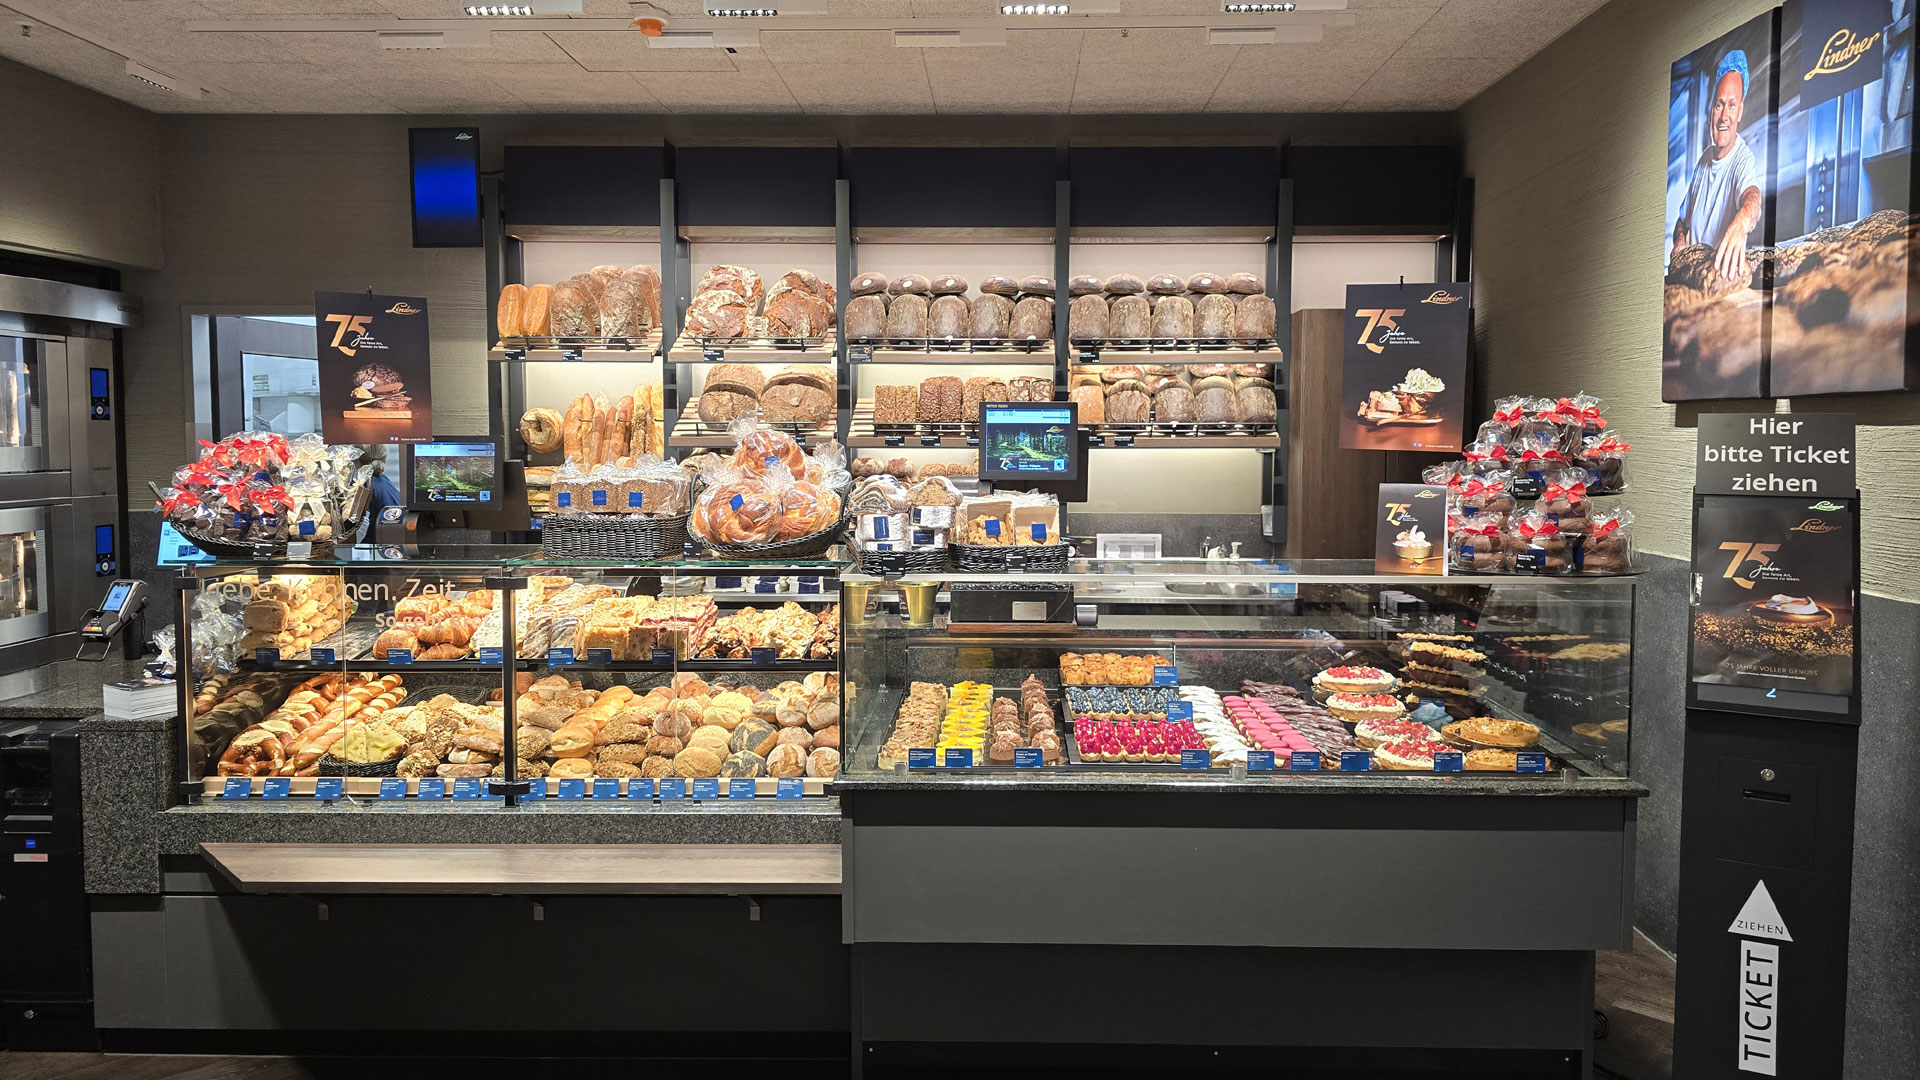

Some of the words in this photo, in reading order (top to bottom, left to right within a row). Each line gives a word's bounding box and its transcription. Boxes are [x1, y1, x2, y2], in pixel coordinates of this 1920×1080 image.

[1803, 28, 1880, 81] Lindner
[1420, 289, 1463, 305] Lindner
[385, 301, 422, 315] Lindner
[324, 313, 373, 357] 75
[1354, 308, 1407, 354] 75
[1750, 418, 1803, 435] Hier
[1704, 445, 1763, 463] bitte
[1770, 445, 1850, 464] Ticket
[1732, 473, 1817, 492] ziehen
[1385, 503, 1412, 526] 75
[1807, 500, 1845, 511] Lindner
[1789, 518, 1842, 534] Lindner
[1718, 541, 1781, 589] 75
[405, 578, 456, 601] Zeit
[375, 613, 396, 628] So
[1736, 663, 1758, 671] JAHRE
[1759, 665, 1787, 674] VOLLER
[1788, 668, 1819, 676] GENUSS
[1737, 920, 1785, 935] ZIEHEN
[1744, 949, 1772, 1061] TICKET
